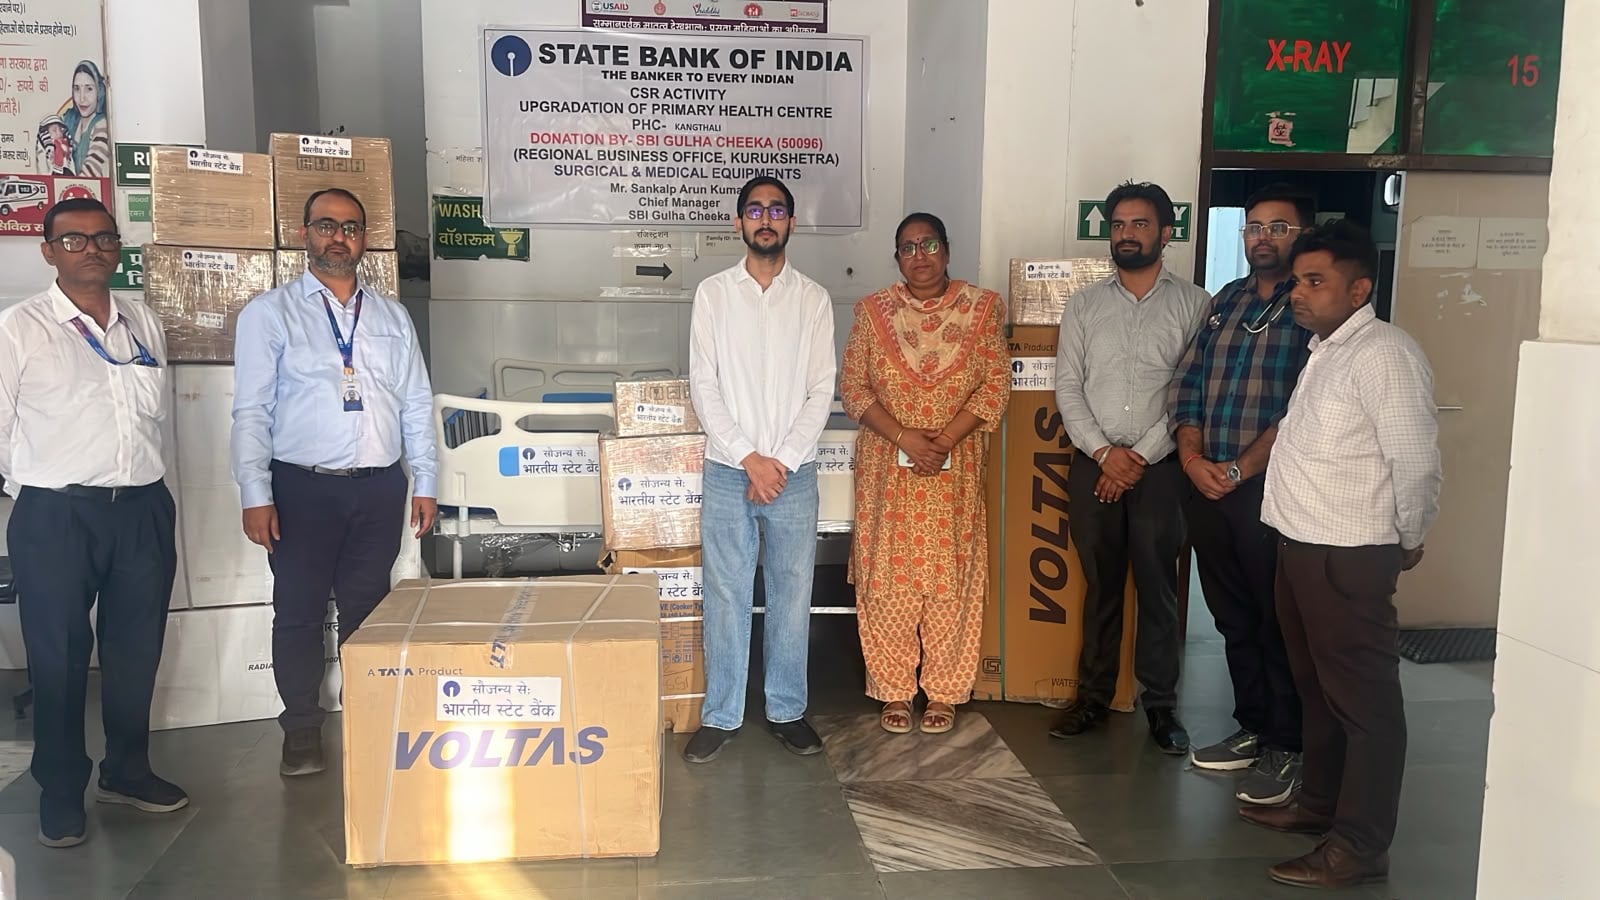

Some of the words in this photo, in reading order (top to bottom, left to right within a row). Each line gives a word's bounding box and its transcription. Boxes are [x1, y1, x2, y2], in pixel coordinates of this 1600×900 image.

[593, 18, 640, 28] सम्मानपर्वक
[538, 43, 630, 66] STATE
[640, 46, 720, 68] BANK
[729, 48, 766, 70] OF
[776, 50, 853, 72] INDIA
[1265, 39, 1352, 73] X-RAY
[602, 70, 627, 80] THE
[631, 71, 683, 82] BANKER
[686, 72, 703, 82] TO
[707, 73, 748, 83] EVERY
[752, 74, 794, 84] INDIAN
[1507, 54, 1540, 88] 15
[630, 88, 660, 99] CSR
[663, 88, 727, 100] ACTIVITY
[520, 100, 624, 114] UPGRADATION
[628, 102, 648, 114] OF
[652, 104, 715, 116] PRIMARY
[719, 105, 773, 118] HEALTH
[777, 106, 832, 118] CENTRE
[632, 119, 666, 130] PHC-
[675, 123, 722, 132] KANGTHALI
[530, 132, 604, 144] DONATION
[609, 134, 632, 146] BY-
[636, 135, 660, 146] SBI
[664, 136, 712, 148] GULHA
[716, 136, 773, 148] CHEEKA
[777, 137, 823, 151] (50096)
[302, 146, 323, 154] भारतीय
[514, 148, 594, 162] (REGIONAL
[598, 150, 668, 161] BUSINESS
[672, 152, 727, 166] OFFICE,
[731, 152, 840, 168] KURUKSHETRA)
[190, 160, 212, 168] भारतीय
[214, 160, 228, 170] स्टेट
[554, 165, 628, 176] SURGICAL
[632, 166, 641, 177] &
[646, 167, 708, 178] MEDICAL
[712, 168, 802, 180] EQUIPMENTS
[610, 183, 628, 193] Mr.
[631, 184, 676, 196] Sankalp
[680, 184, 707, 194] Arun
[710, 185, 742, 194] Kuma
[638, 197, 668, 207] Chief
[672, 198, 720, 210] Manager
[438, 204, 480, 218] WASH
[628, 210, 648, 220] SBI
[652, 210, 686, 220] Gulha
[689, 211, 730, 221] Cheeka
[438, 228, 496, 246] वॉशरूम
[1008, 343, 1021, 351] TA
[1024, 343, 1054, 352] Product
[1012, 374, 1047, 387] भारतीय
[818, 448, 836, 456] जन्य
[523, 460, 558, 474] भारतीय
[562, 460, 582, 474] स्टेट
[825, 458, 845, 471] स्टेट
[619, 491, 656, 506] भारतीय
[659, 490, 680, 505] स्टेट
[1029, 406, 1073, 624] VOLTAS
[654, 570, 678, 580] जन्य
[668, 584, 688, 597] स्टेट
[368, 669, 376, 677] A
[378, 668, 414, 676] TATA
[418, 668, 464, 676] Product
[443, 698, 490, 717] भारतीय
[496, 699, 526, 718] स्टेट
[530, 698, 556, 718] बैंक
[394, 726, 608, 770] VOLTAS
